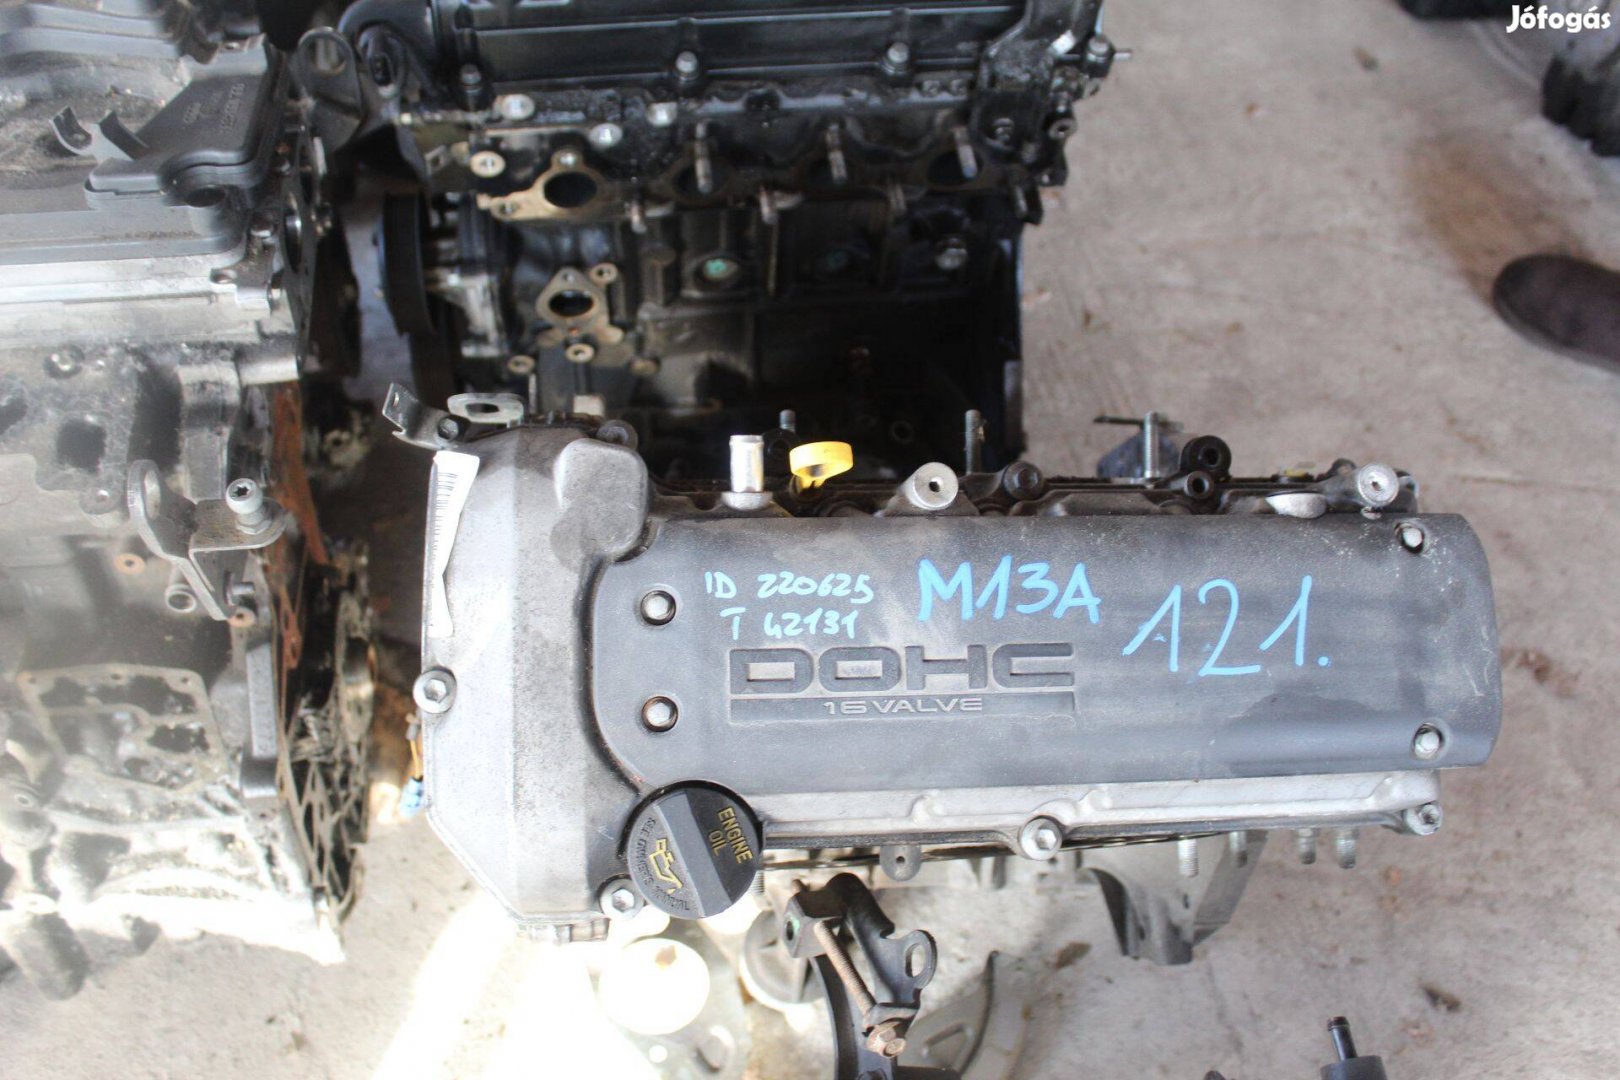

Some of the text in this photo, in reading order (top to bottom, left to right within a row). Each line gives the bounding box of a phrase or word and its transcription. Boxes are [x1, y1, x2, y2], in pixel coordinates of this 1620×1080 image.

[705, 571, 875, 605] ID 220625
[917, 554, 1102, 625] M13A
[719, 606, 861, 640] T 42131
[729, 642, 1075, 695] DOHC
[708, 829, 727, 857] OIL
[717, 806, 753, 864] ENGINE
